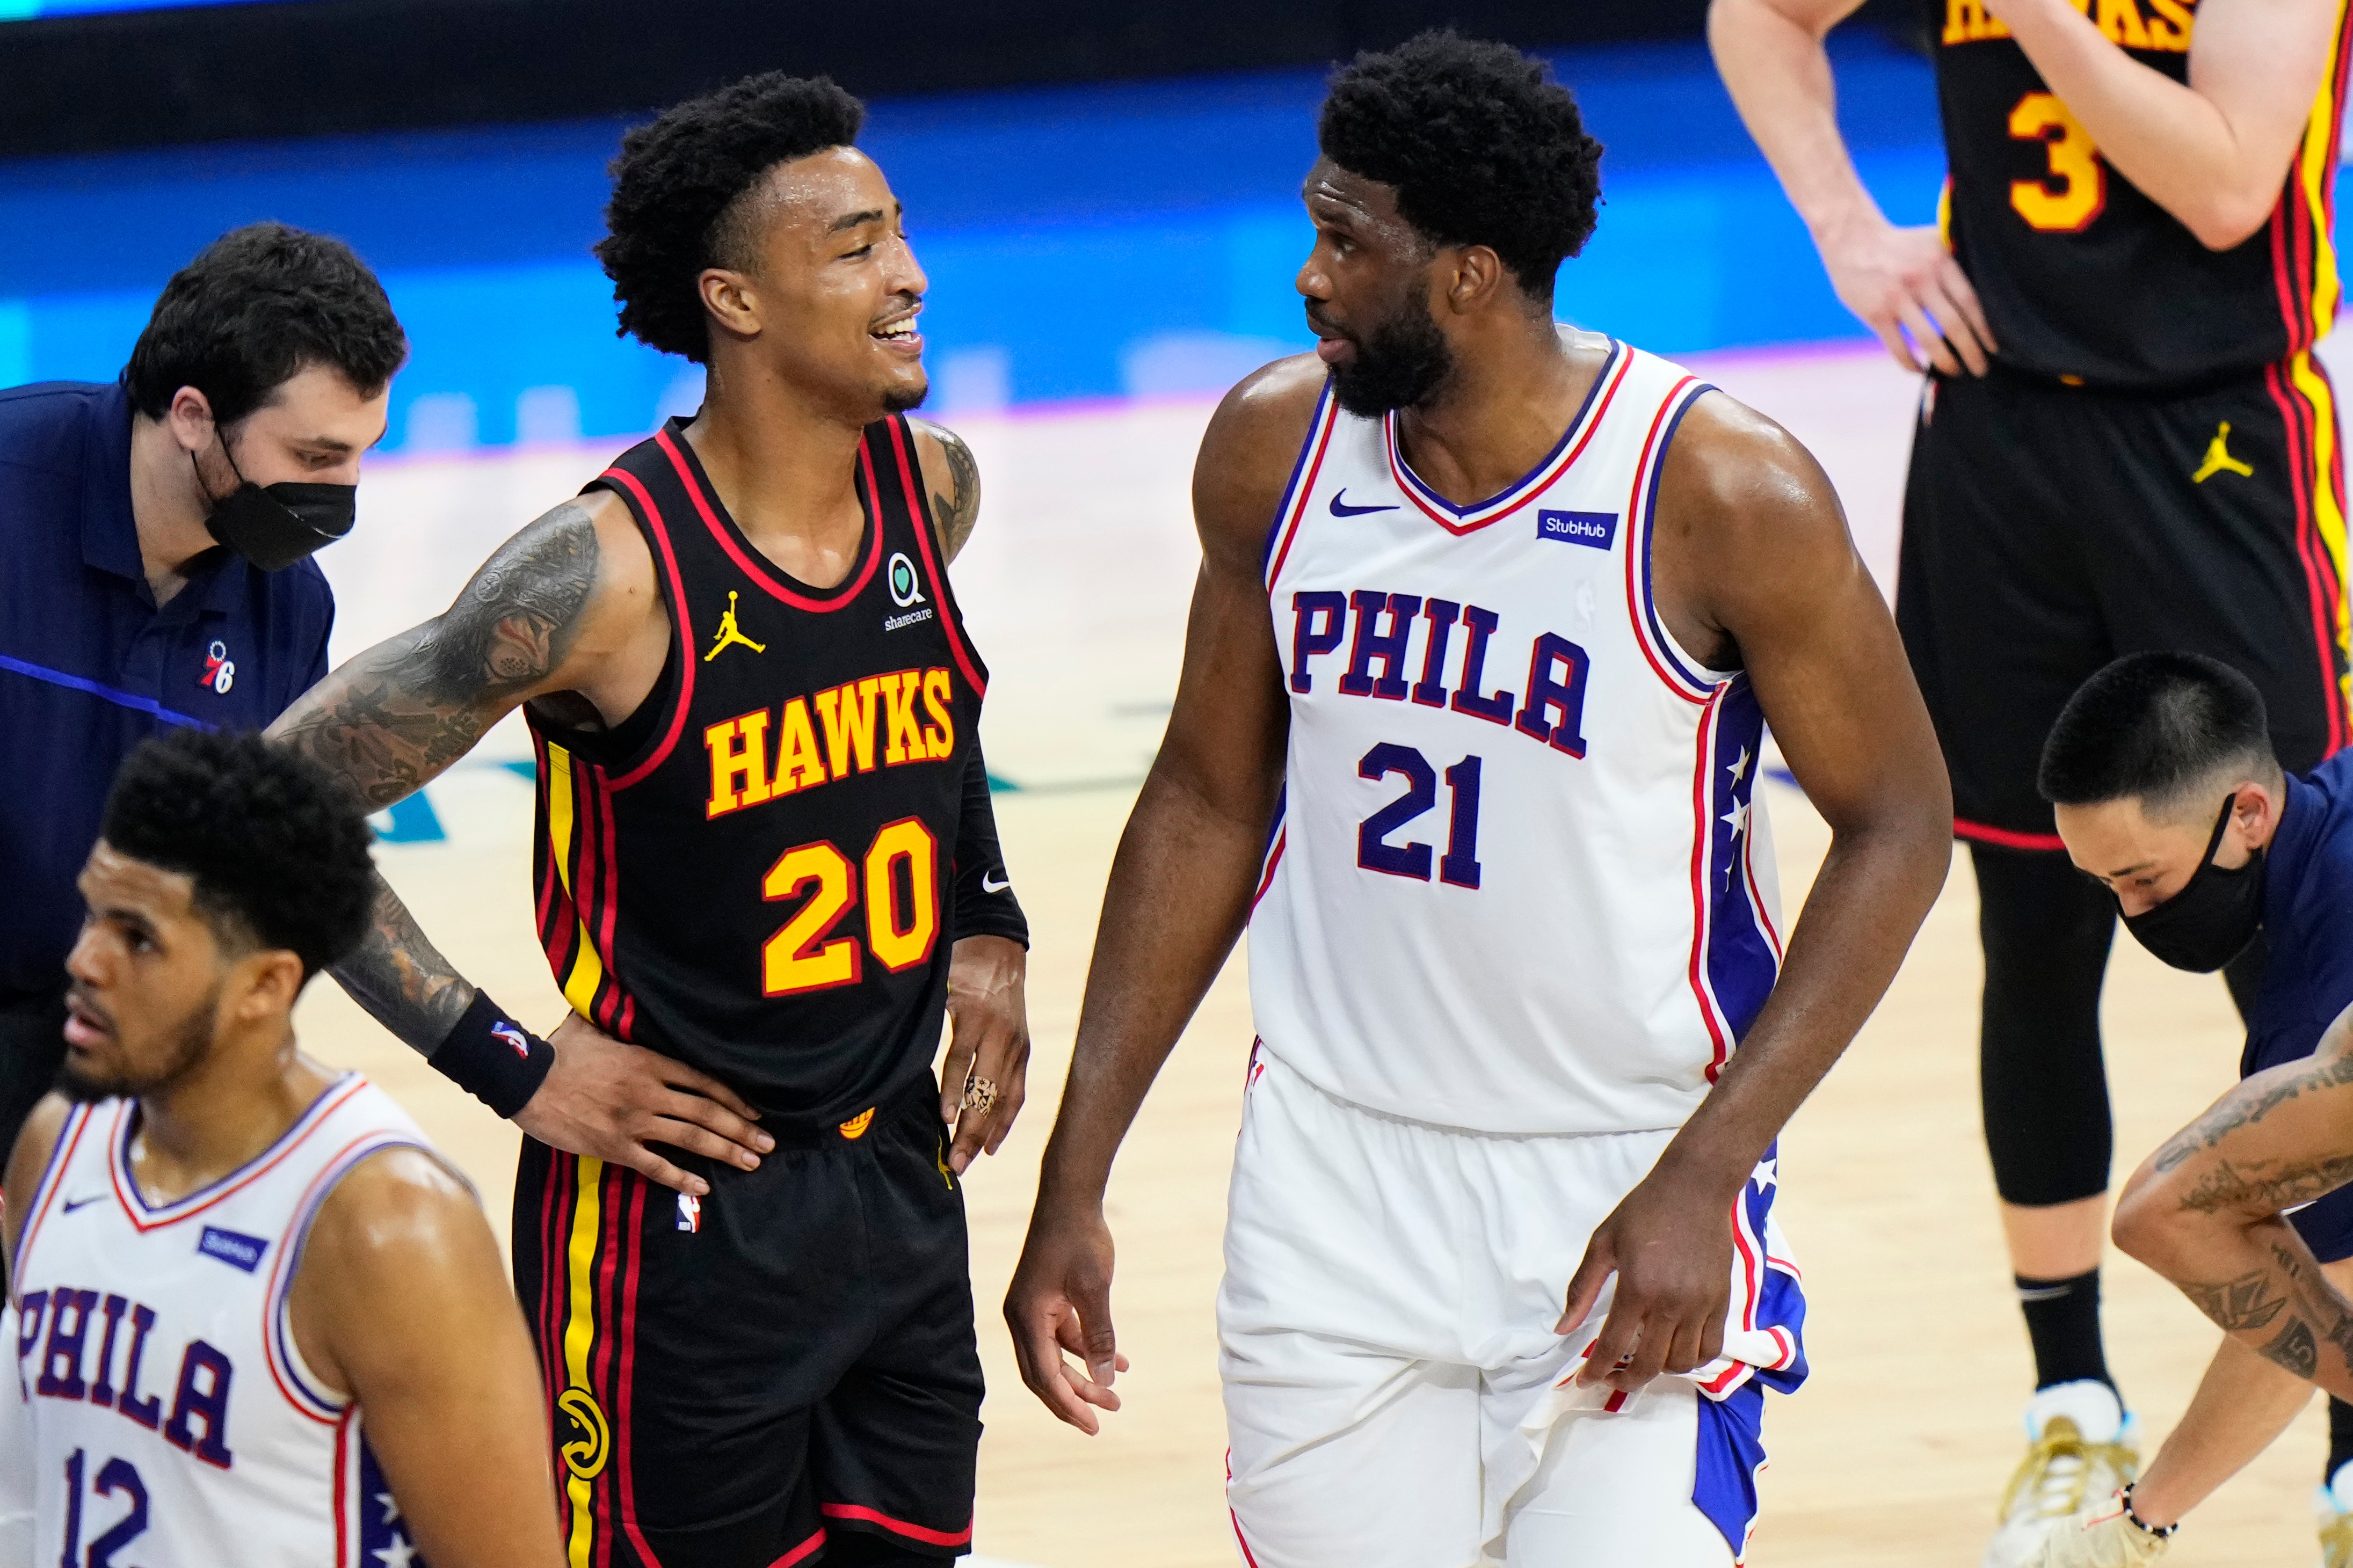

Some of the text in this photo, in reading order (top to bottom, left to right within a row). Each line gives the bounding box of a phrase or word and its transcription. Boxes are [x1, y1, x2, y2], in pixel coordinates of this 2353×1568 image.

[2008, 90, 2108, 233] 3
[1545, 517, 1606, 538] StubHub
[200, 654, 235, 694] 76
[884, 608, 933, 631] sharecare
[1291, 589, 1590, 760] PHILA
[704, 666, 954, 820] HAWKS
[1357, 741, 1481, 890] 21
[761, 815, 938, 998] 20
[19, 1287, 233, 1470] PHILA
[60, 1448, 148, 1568] 12
